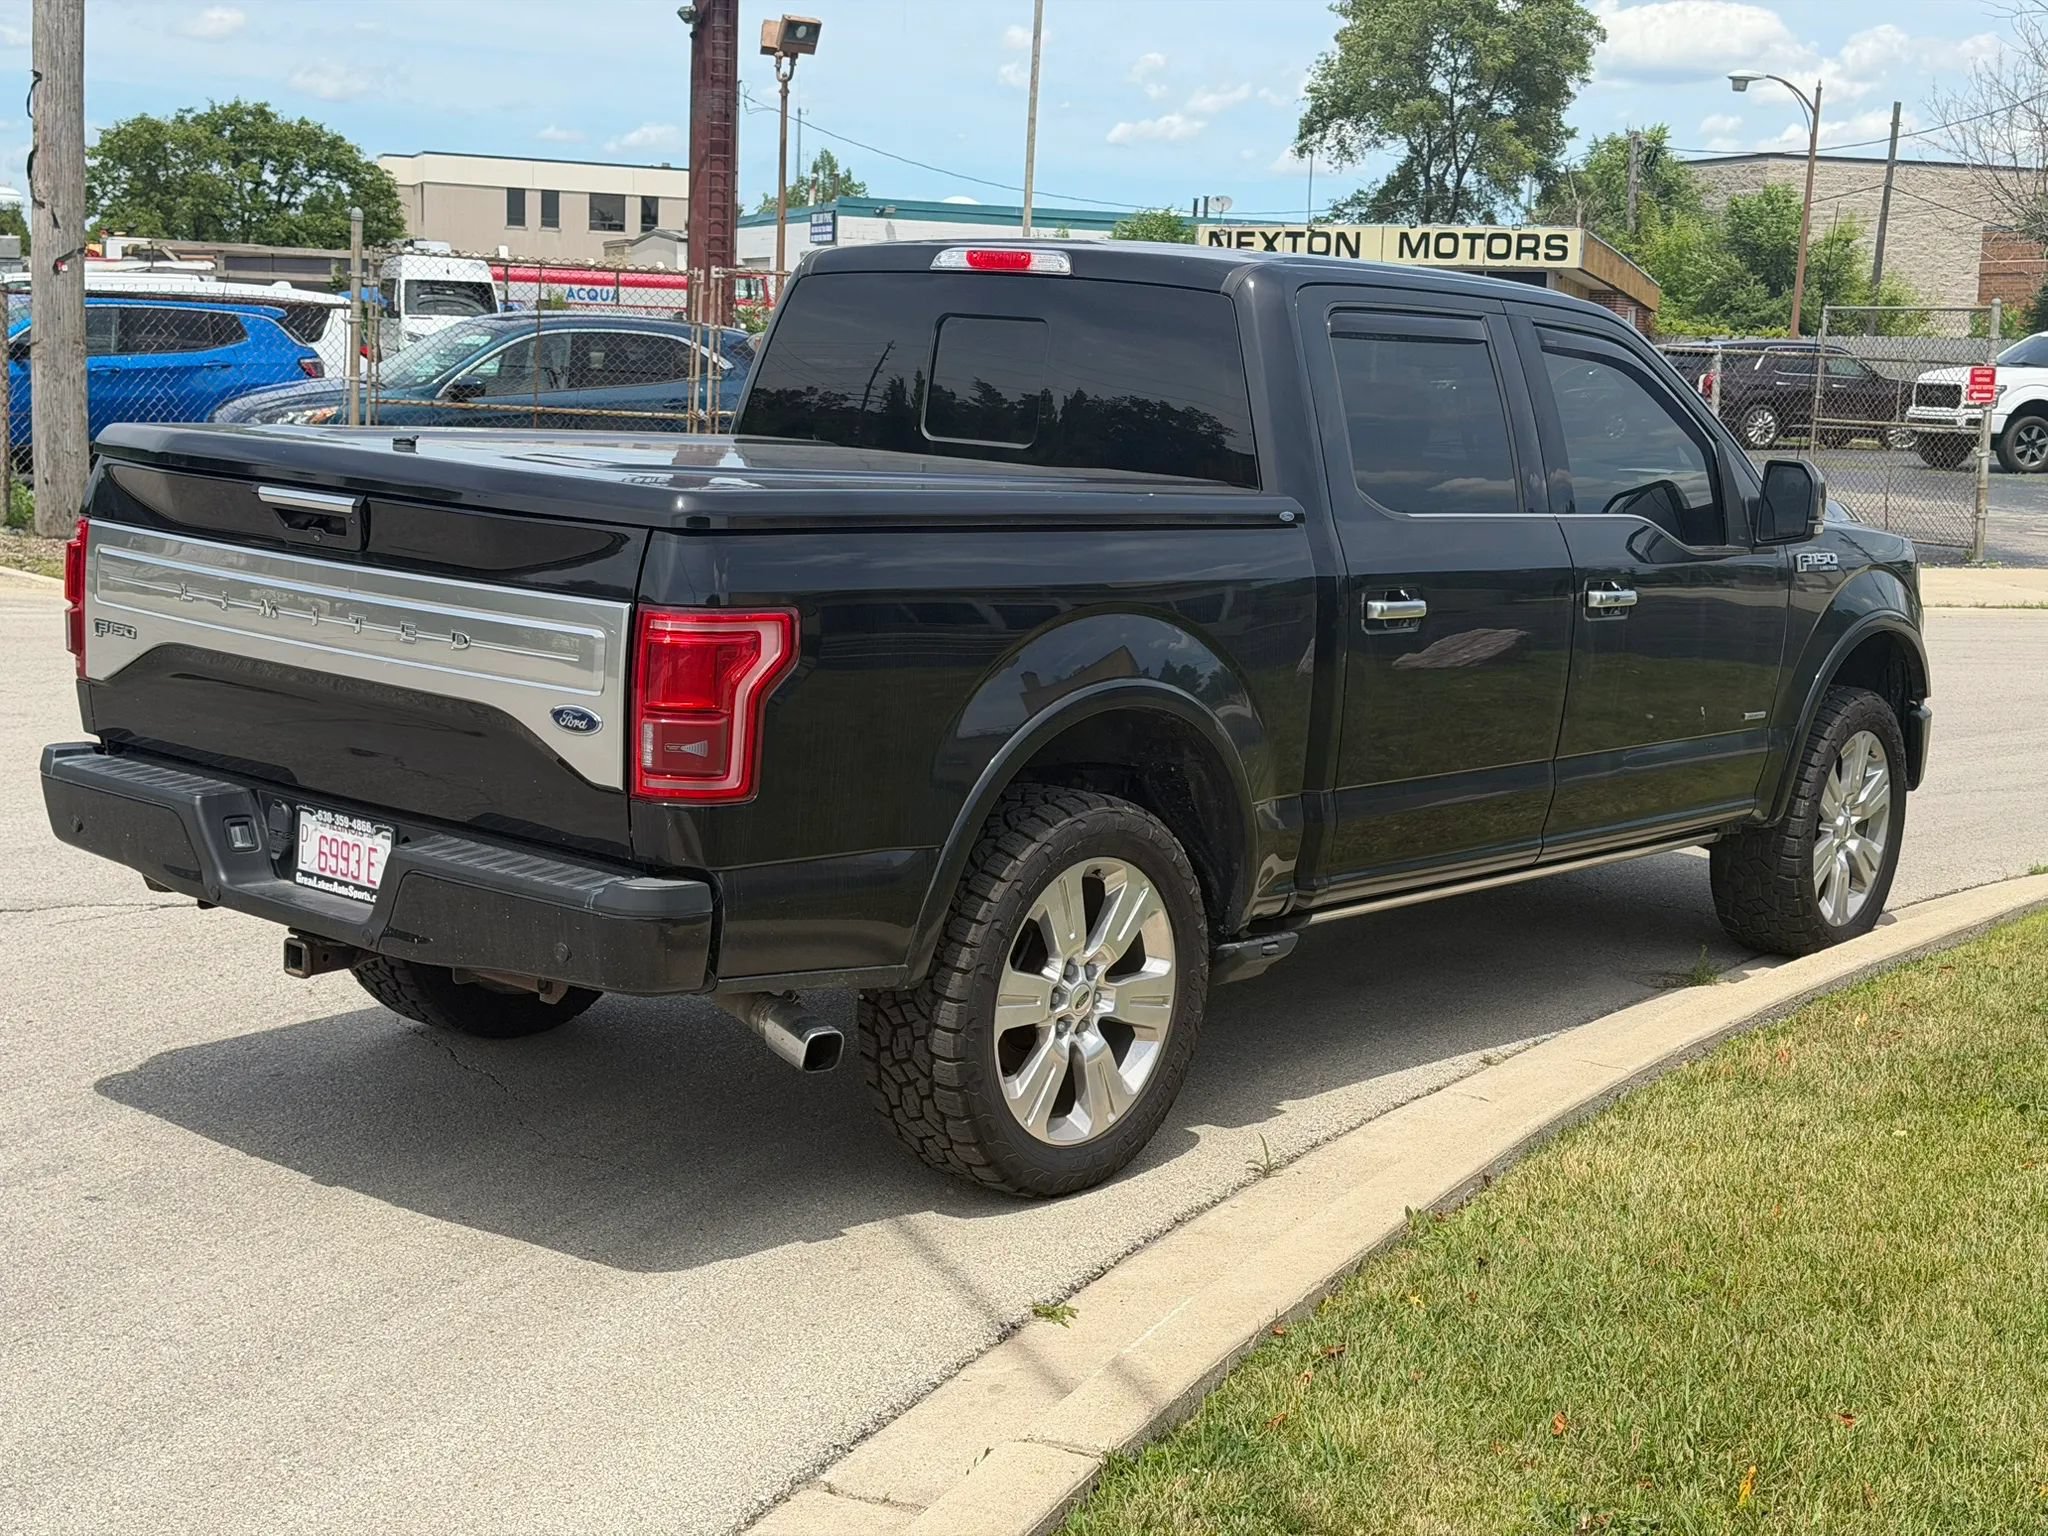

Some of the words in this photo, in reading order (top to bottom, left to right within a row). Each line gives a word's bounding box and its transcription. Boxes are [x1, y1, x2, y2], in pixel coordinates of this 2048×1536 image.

[1208, 231, 1361, 258] NEXTON
[1398, 231, 1569, 262] MOTORS
[177, 582, 472, 651] LIMITED
[558, 709, 589, 730] Ford
[318, 835, 361, 880] 6993
[367, 846, 378, 887] E
